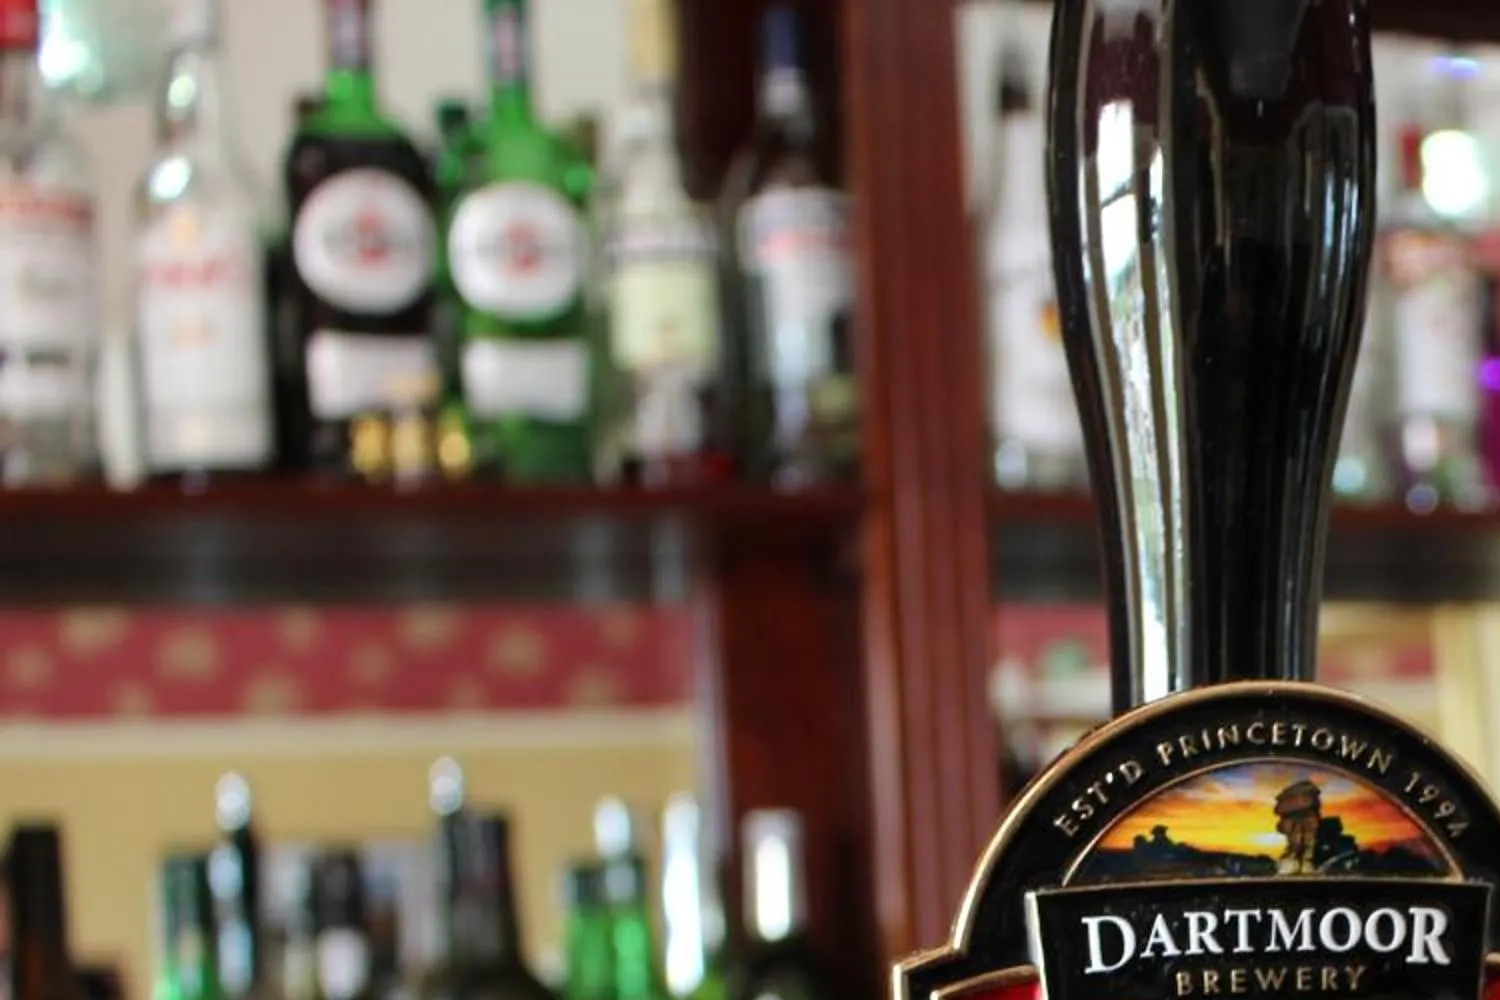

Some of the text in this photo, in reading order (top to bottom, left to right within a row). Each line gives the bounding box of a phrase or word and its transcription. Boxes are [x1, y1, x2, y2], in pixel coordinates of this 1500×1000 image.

[1053, 721, 1469, 838] EST'D PRINCETOWN 1994
[1081, 906, 1452, 976] DARTMOOR
[1175, 964, 1367, 998] BREWERY
